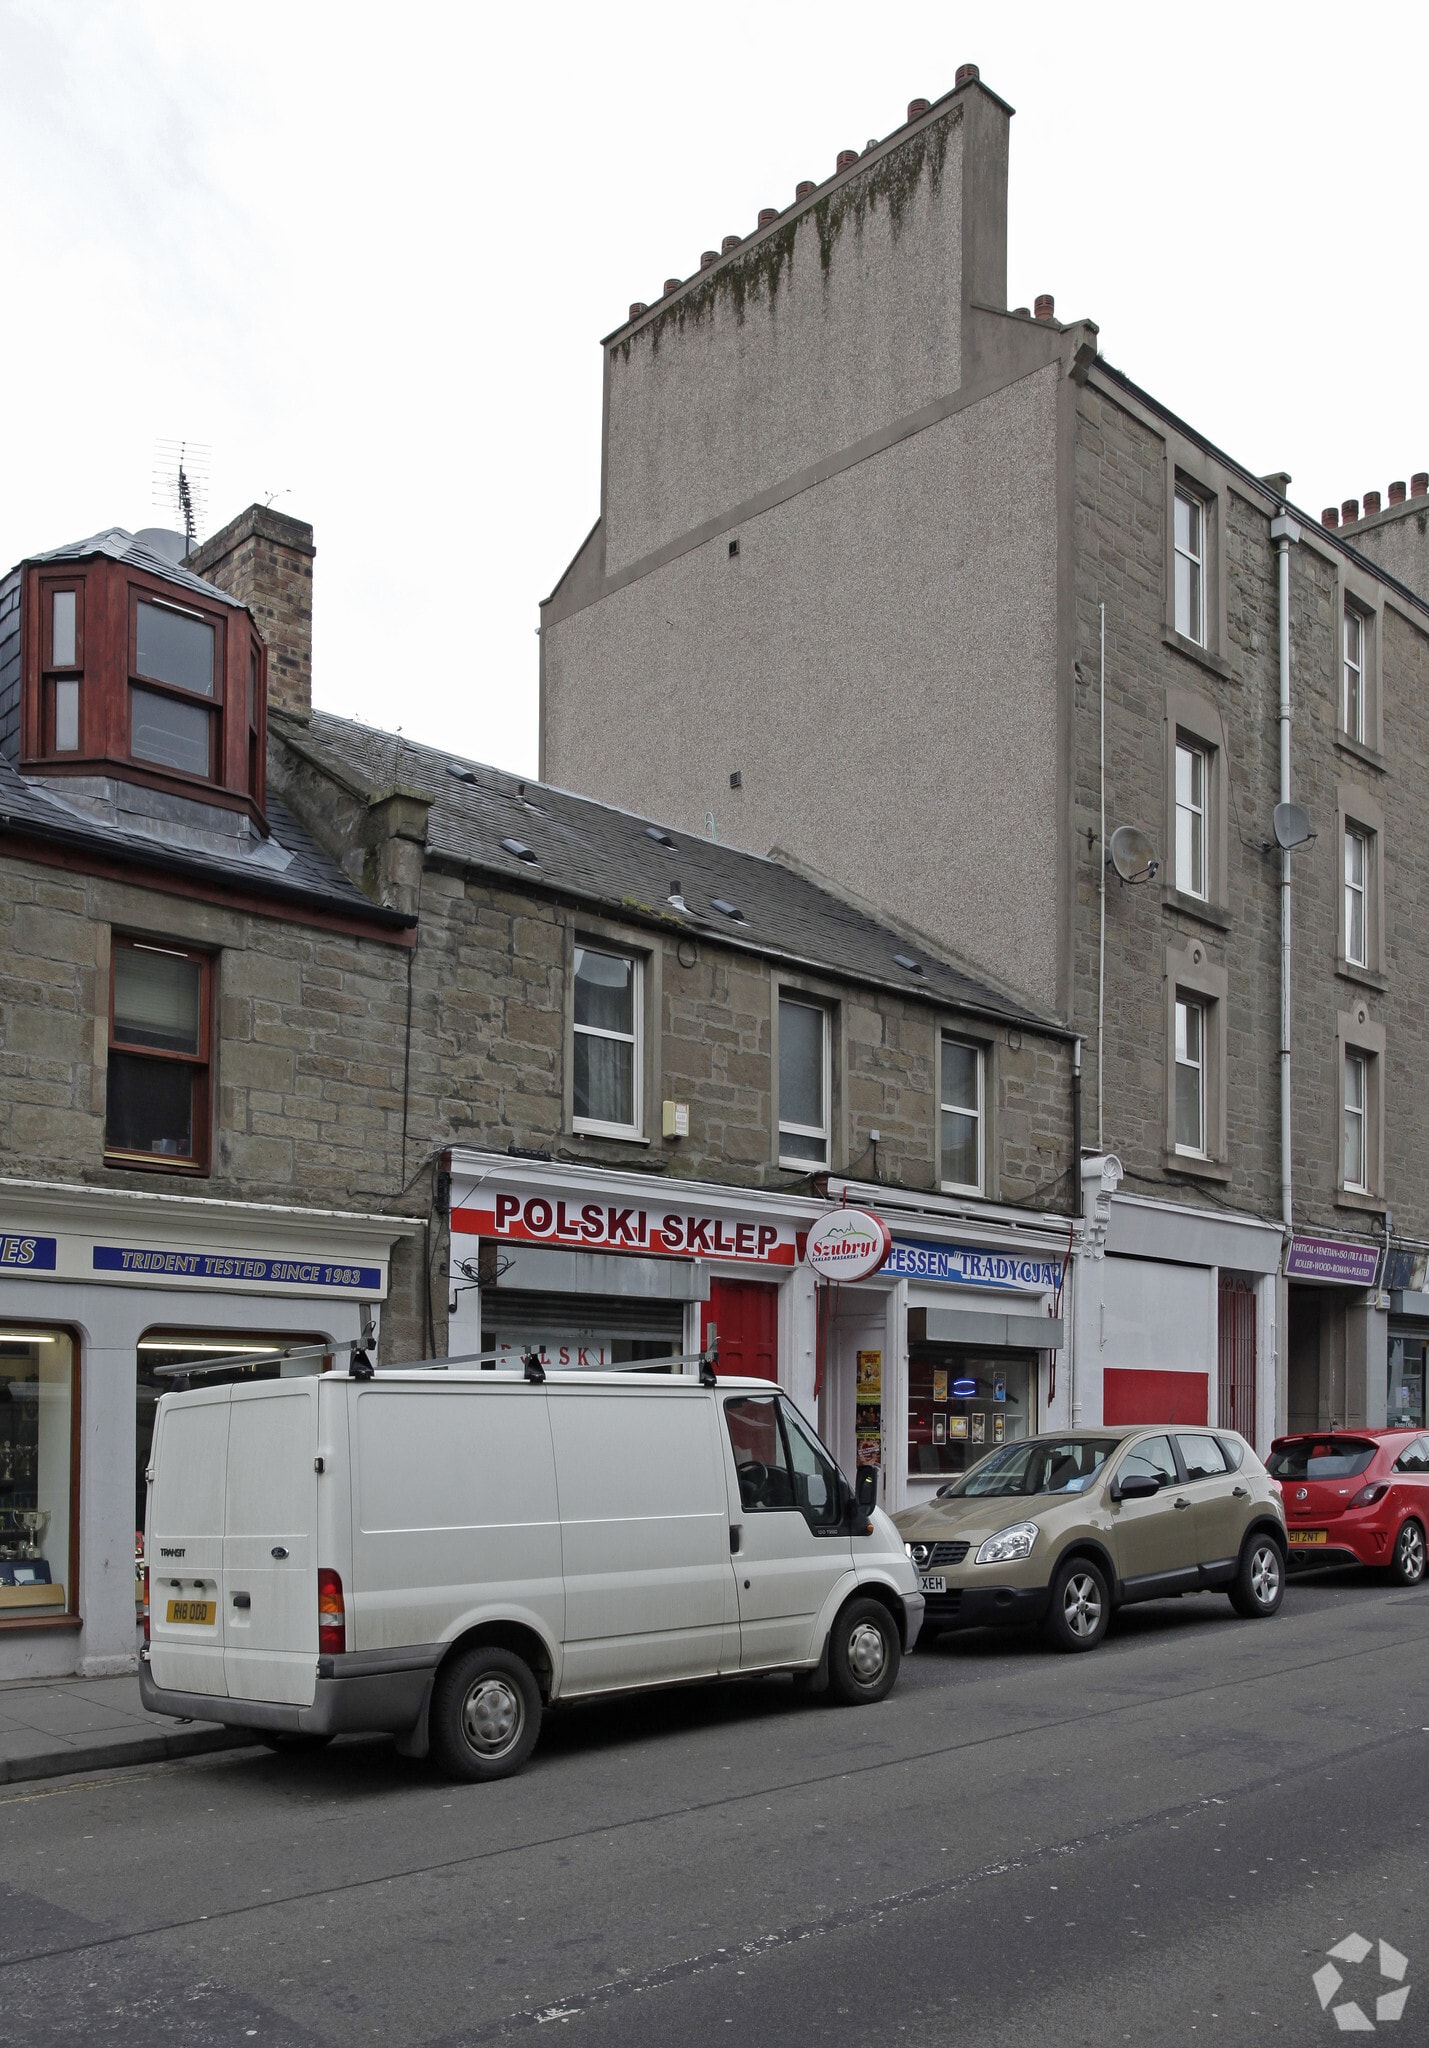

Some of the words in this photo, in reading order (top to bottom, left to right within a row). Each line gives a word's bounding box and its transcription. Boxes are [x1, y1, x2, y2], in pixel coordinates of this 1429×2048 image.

[495, 1193, 649, 1246] POLSKI
[661, 1214, 779, 1258] SKLEP
[0, 1237, 37, 1264] ES
[812, 1239, 878, 1258] Szubryt
[121, 1251, 199, 1274] TRIDENT
[204, 1256, 267, 1278] TESTED
[270, 1263, 320, 1282] SINCE
[323, 1267, 362, 1285] 1983
[882, 1247, 949, 1276] TESSEN
[1302, 1532, 1319, 1541] ZNT
[160, 1548, 185, 1557] TRANSIT
[922, 1577, 943, 1589] XEH
